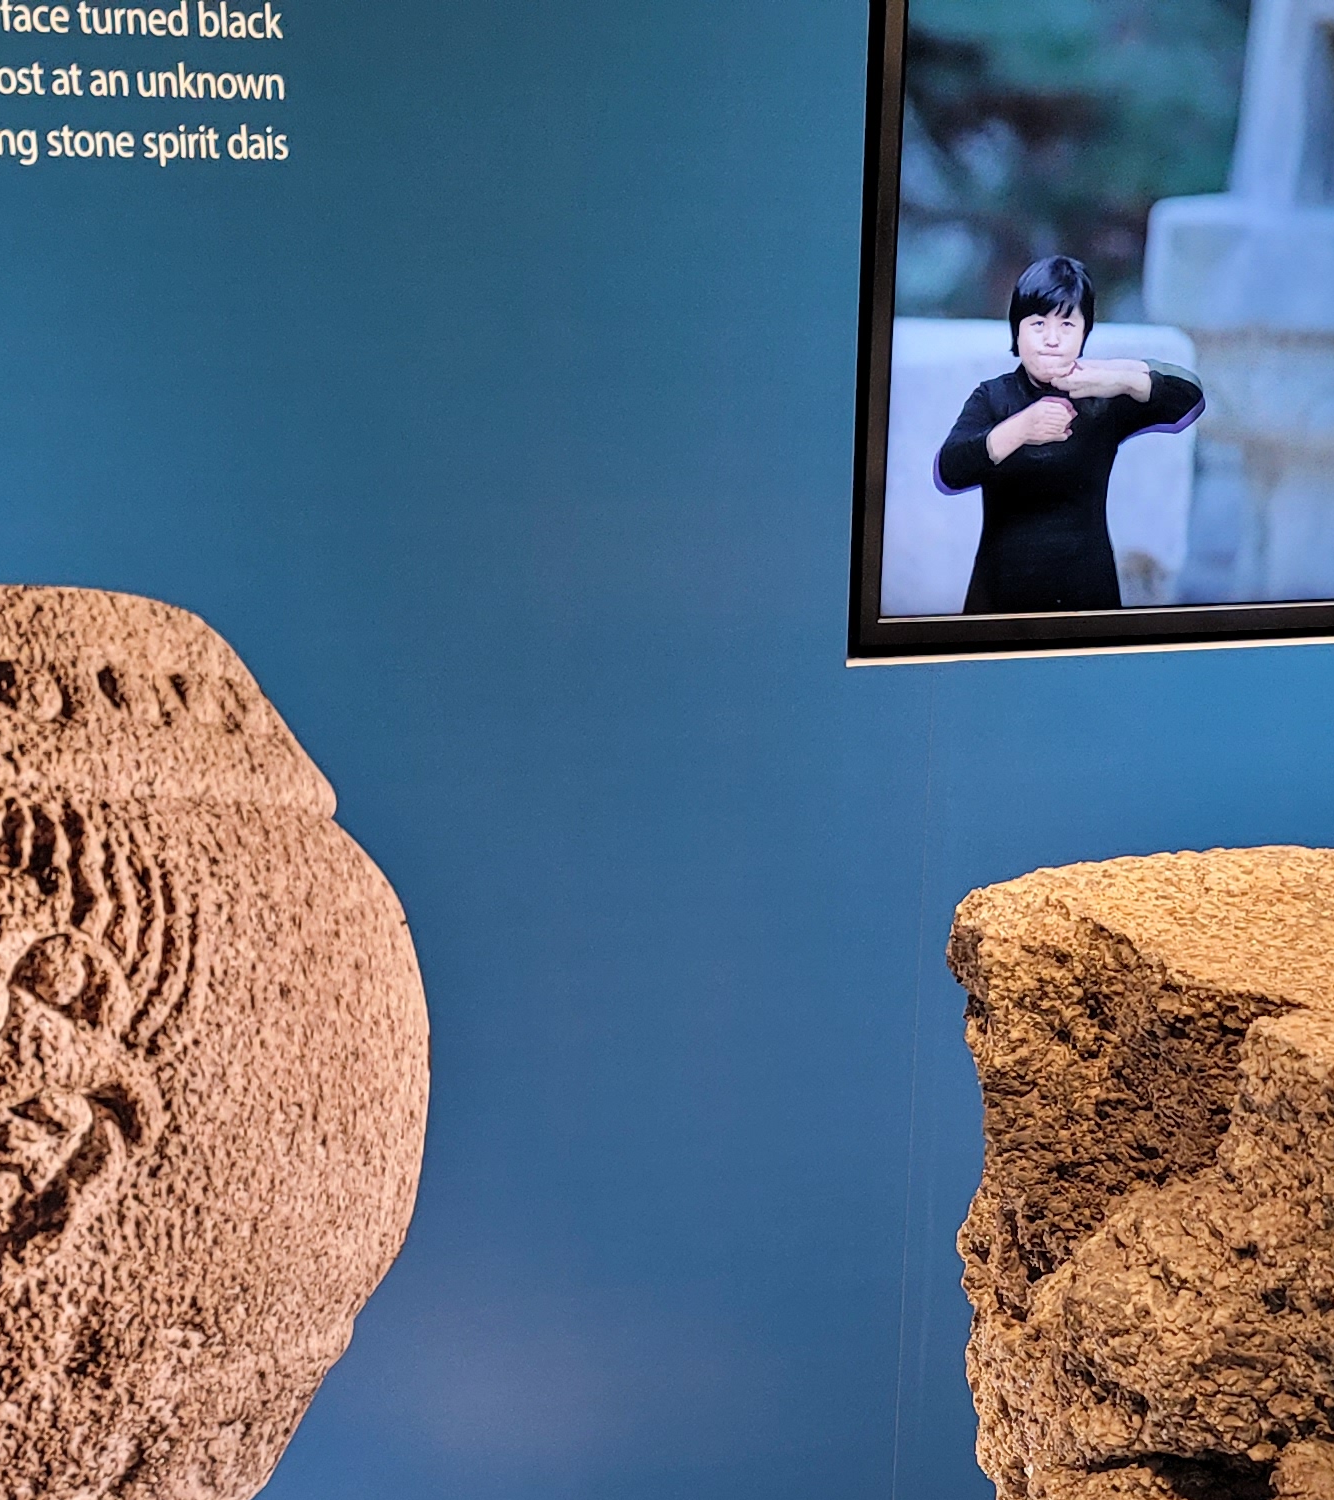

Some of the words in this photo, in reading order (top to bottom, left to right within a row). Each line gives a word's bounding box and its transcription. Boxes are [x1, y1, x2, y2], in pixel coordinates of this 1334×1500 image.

[76, 0, 189, 37] turned
[197, 0, 284, 39] black
[51, 63, 83, 96] at
[90, 68, 129, 97] an
[137, 62, 285, 101] unknown
[47, 125, 134, 158] stone
[143, 125, 220, 168] spirit
[227, 124, 289, 160] dais
